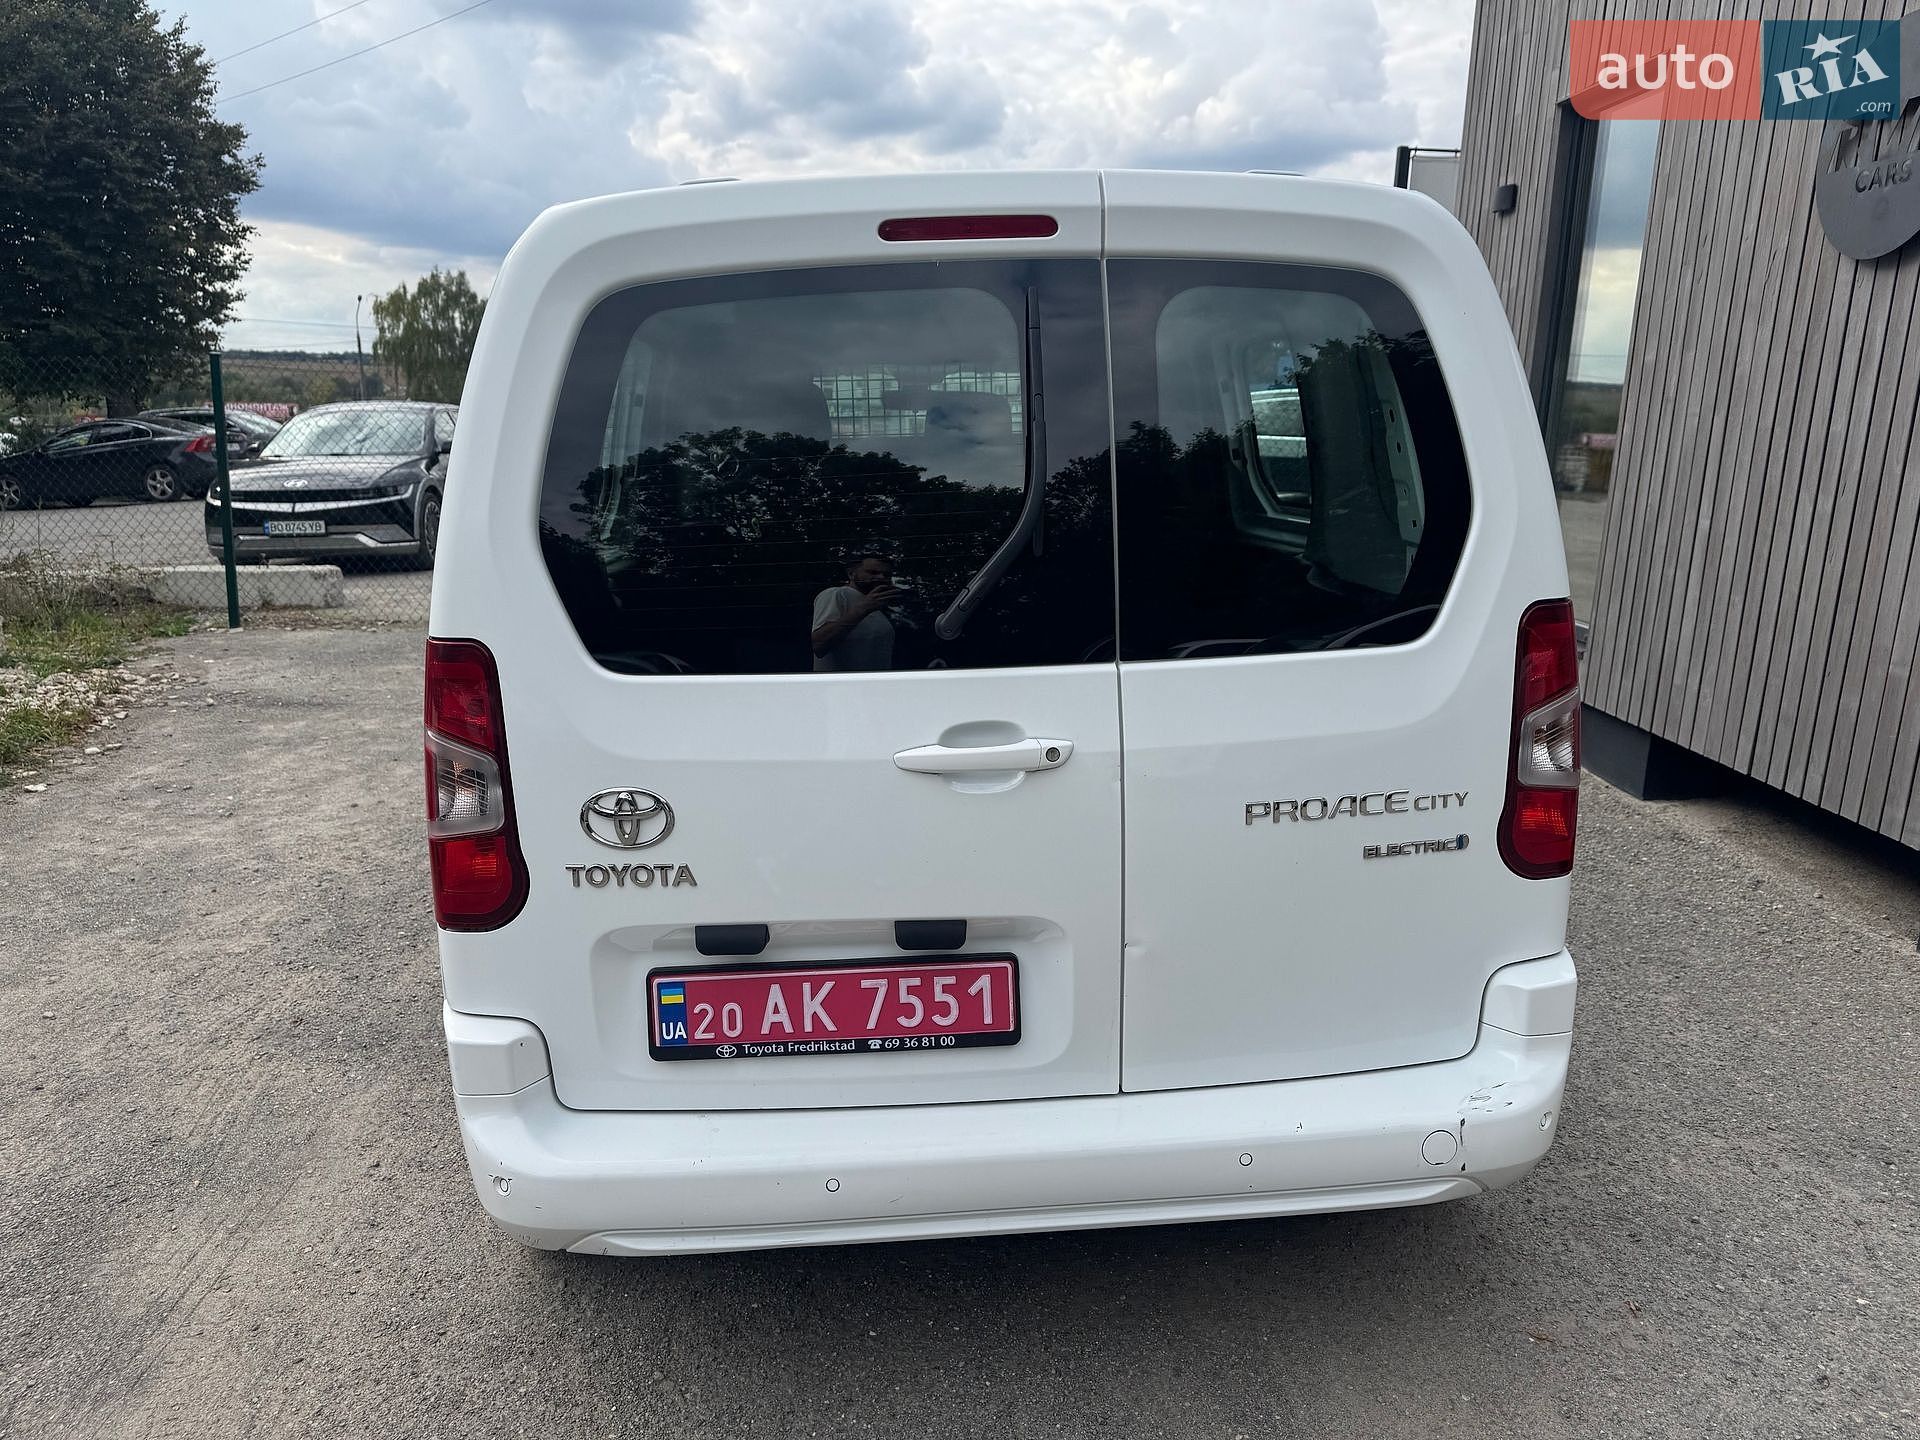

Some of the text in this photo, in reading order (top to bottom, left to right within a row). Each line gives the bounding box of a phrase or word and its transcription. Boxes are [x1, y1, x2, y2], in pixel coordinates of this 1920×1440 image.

[1855, 159, 1913, 193] CARS
[1244, 789, 1469, 826] PROACE CITY
[1362, 836, 1458, 859] ELECTRIC
[565, 863, 698, 889] TOYOTA
[661, 972, 994, 1040] UA 20 AK 7551
[742, 1036, 956, 1057] Toyota Fredrikstad 69 36 81 00
